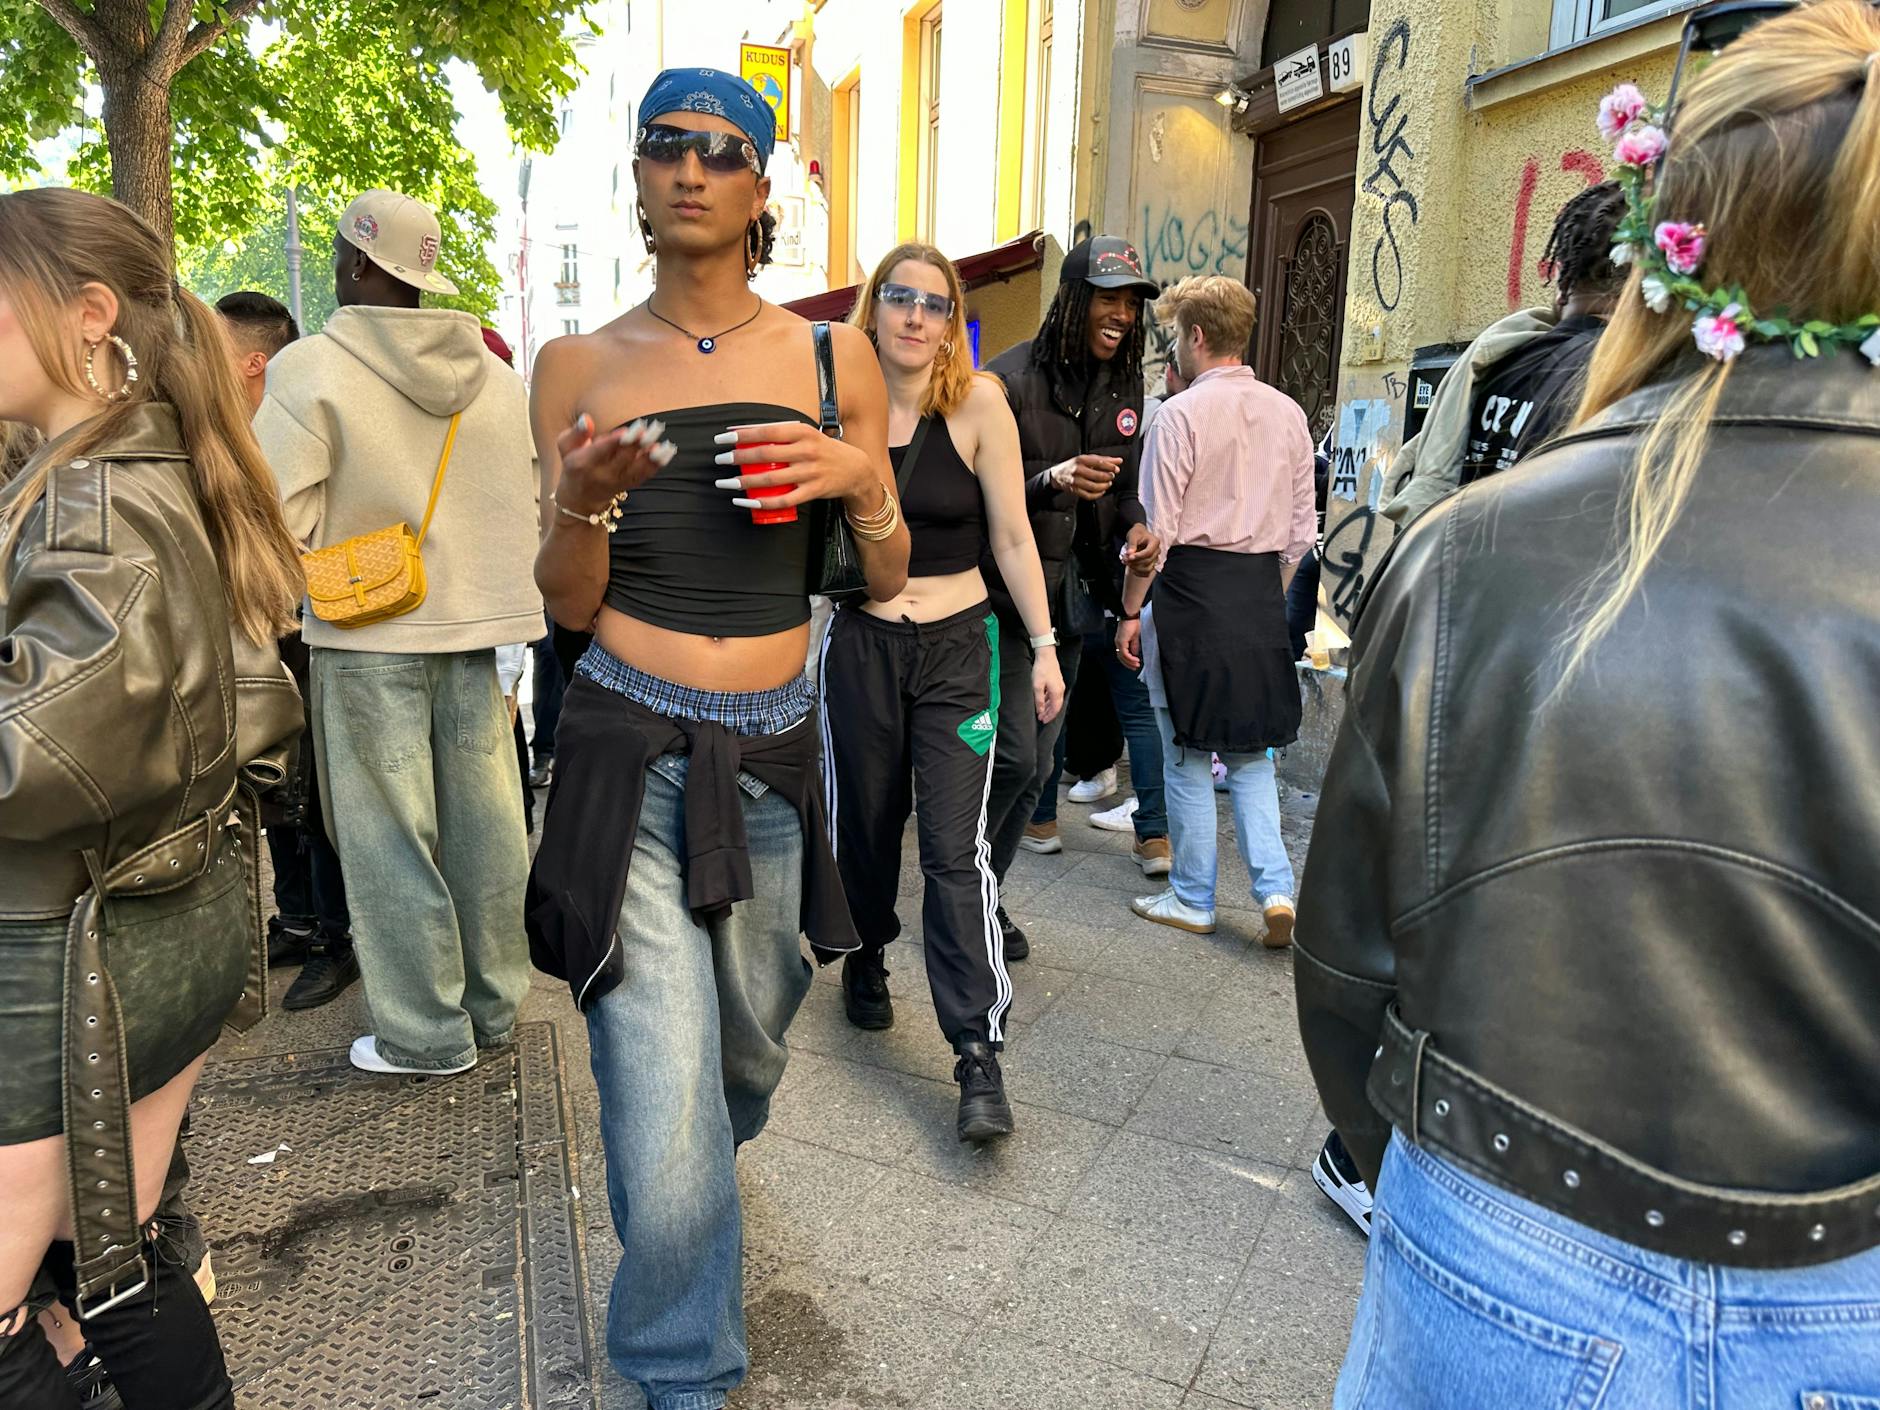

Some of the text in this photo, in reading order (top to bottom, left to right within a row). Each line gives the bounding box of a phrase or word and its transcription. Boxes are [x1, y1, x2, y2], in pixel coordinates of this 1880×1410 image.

[745, 51, 785, 66] KUDUS
[1332, 47, 1350, 80] 89
[1419, 385, 1430, 395] EYE
